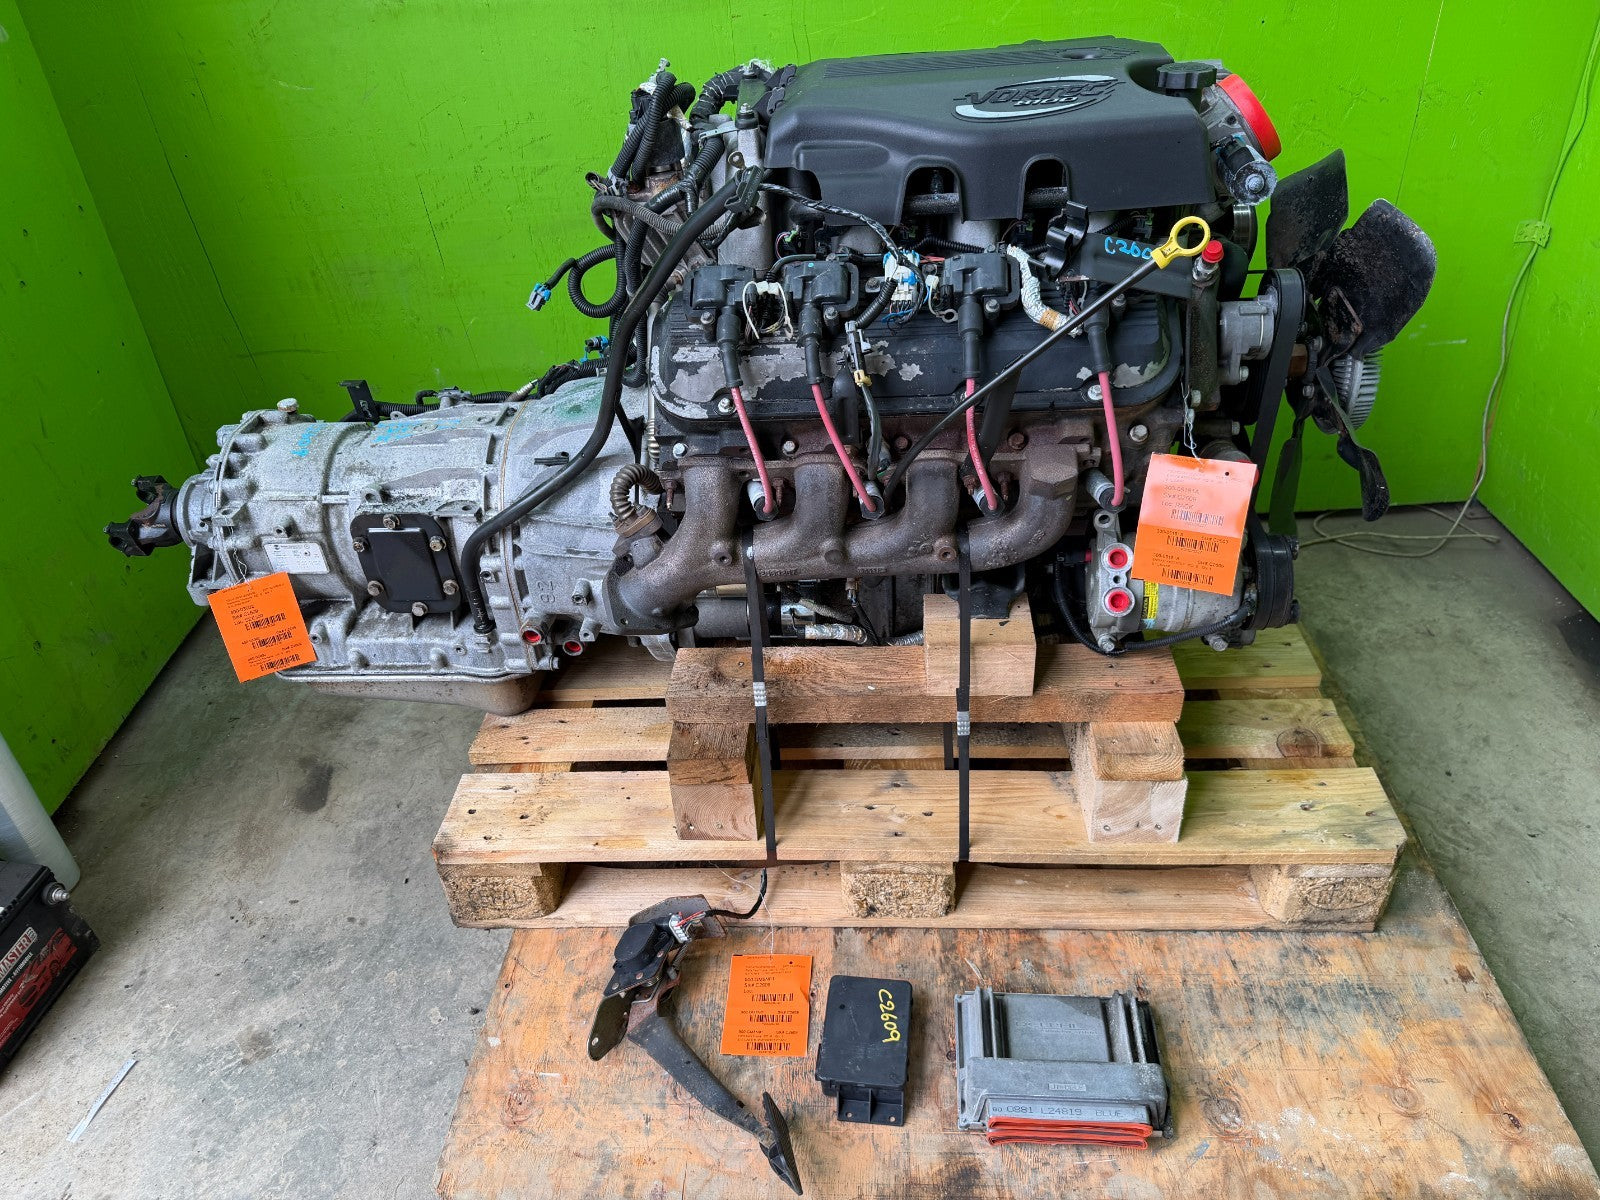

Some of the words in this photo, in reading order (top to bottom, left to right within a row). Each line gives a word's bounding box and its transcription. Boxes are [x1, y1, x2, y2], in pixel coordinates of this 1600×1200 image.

[964, 82, 1112, 105] VORTEC
[0, 936, 30, 979] MASTER
[878, 988, 901, 1043] C2609
